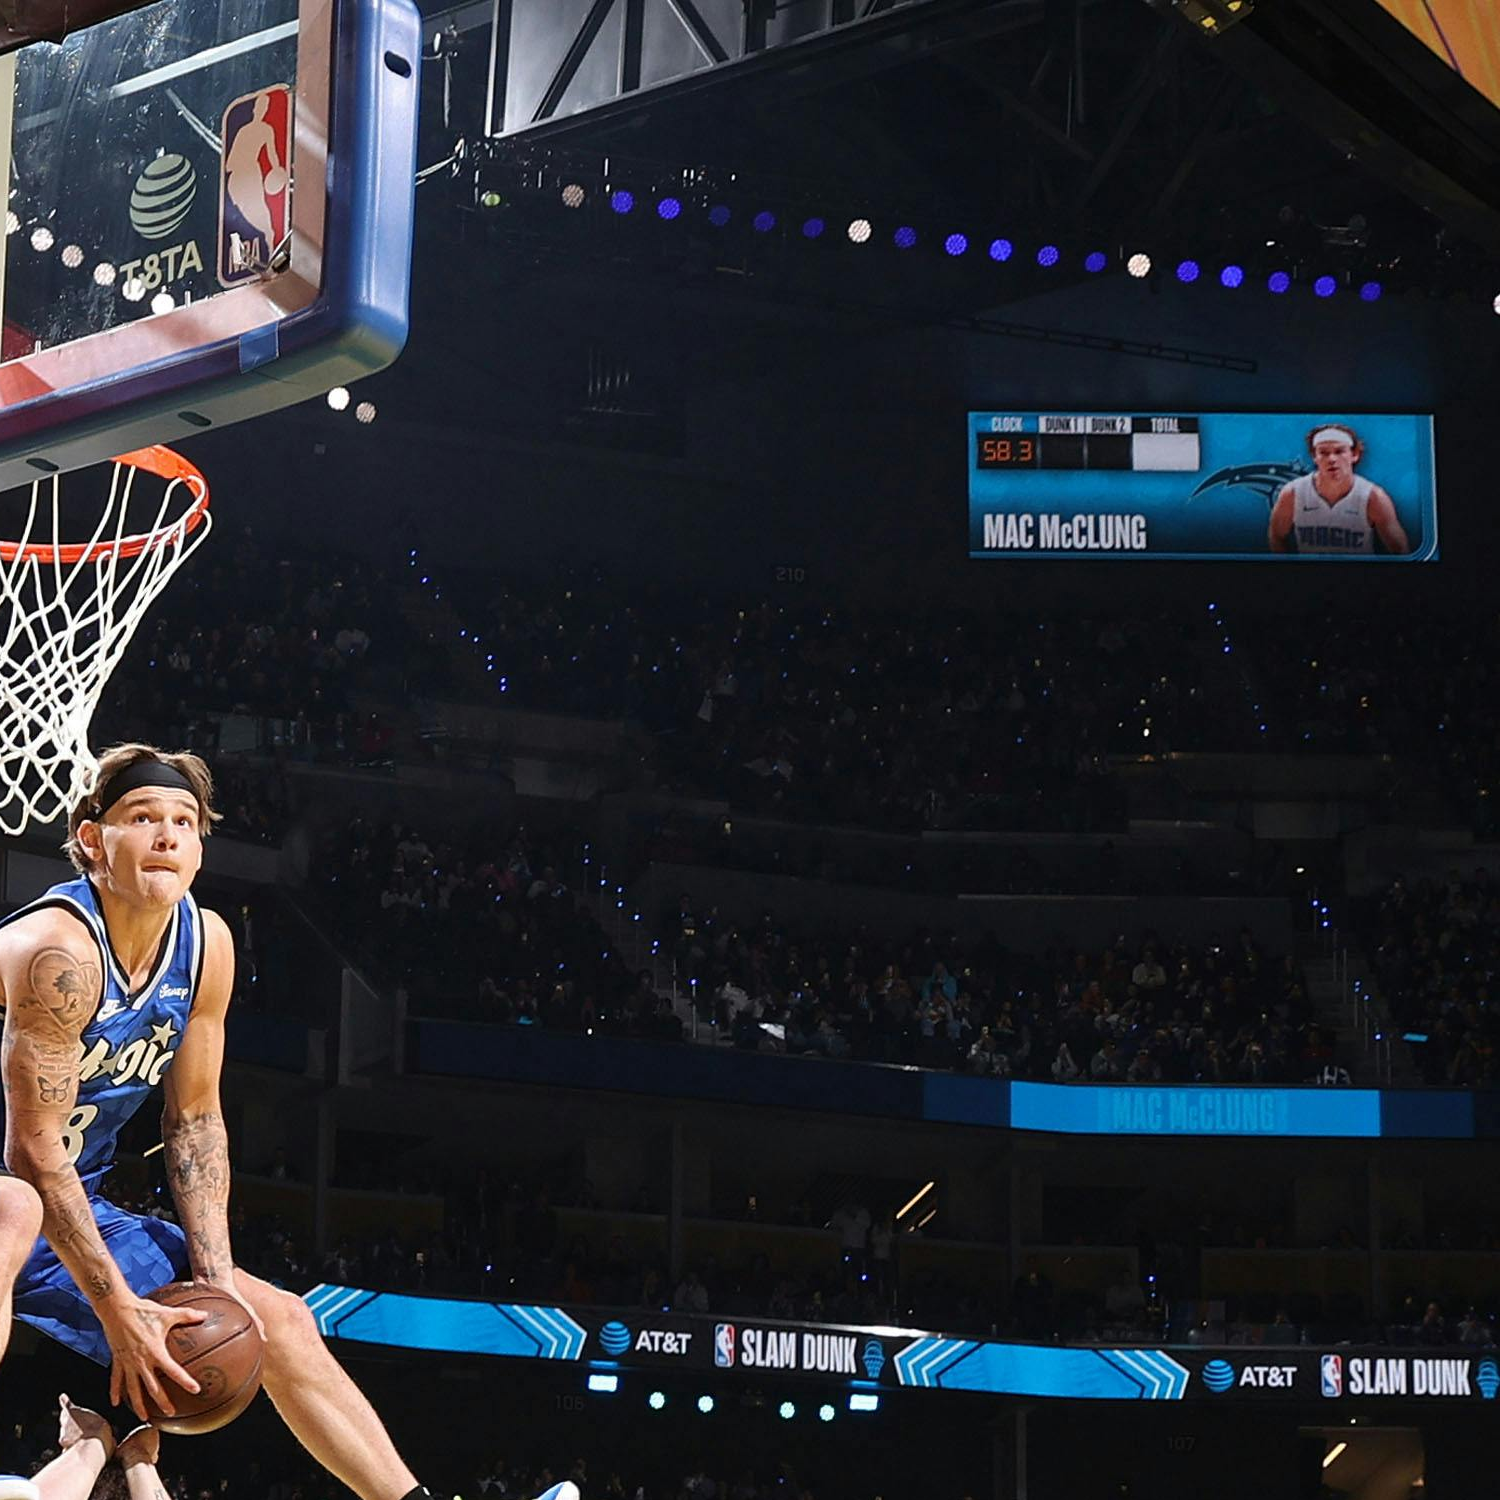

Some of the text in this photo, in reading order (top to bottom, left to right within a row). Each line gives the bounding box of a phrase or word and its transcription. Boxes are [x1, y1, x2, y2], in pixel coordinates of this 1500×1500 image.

[991, 417, 1022, 432] CLOCK
[1046, 417, 1071, 432] DUNK
[1151, 418, 1179, 432] TOTAL
[983, 440, 1033, 461] 58.3
[984, 514, 1146, 549] MAC McCLUNG
[1113, 1091, 1275, 1132] MAC McCLUNG
[634, 1330, 691, 1354] AT&T
[741, 1328, 857, 1374] SLAM DUNK
[1239, 1366, 1297, 1387] AT&T
[1349, 1358, 1471, 1396] SLAM DUNK
